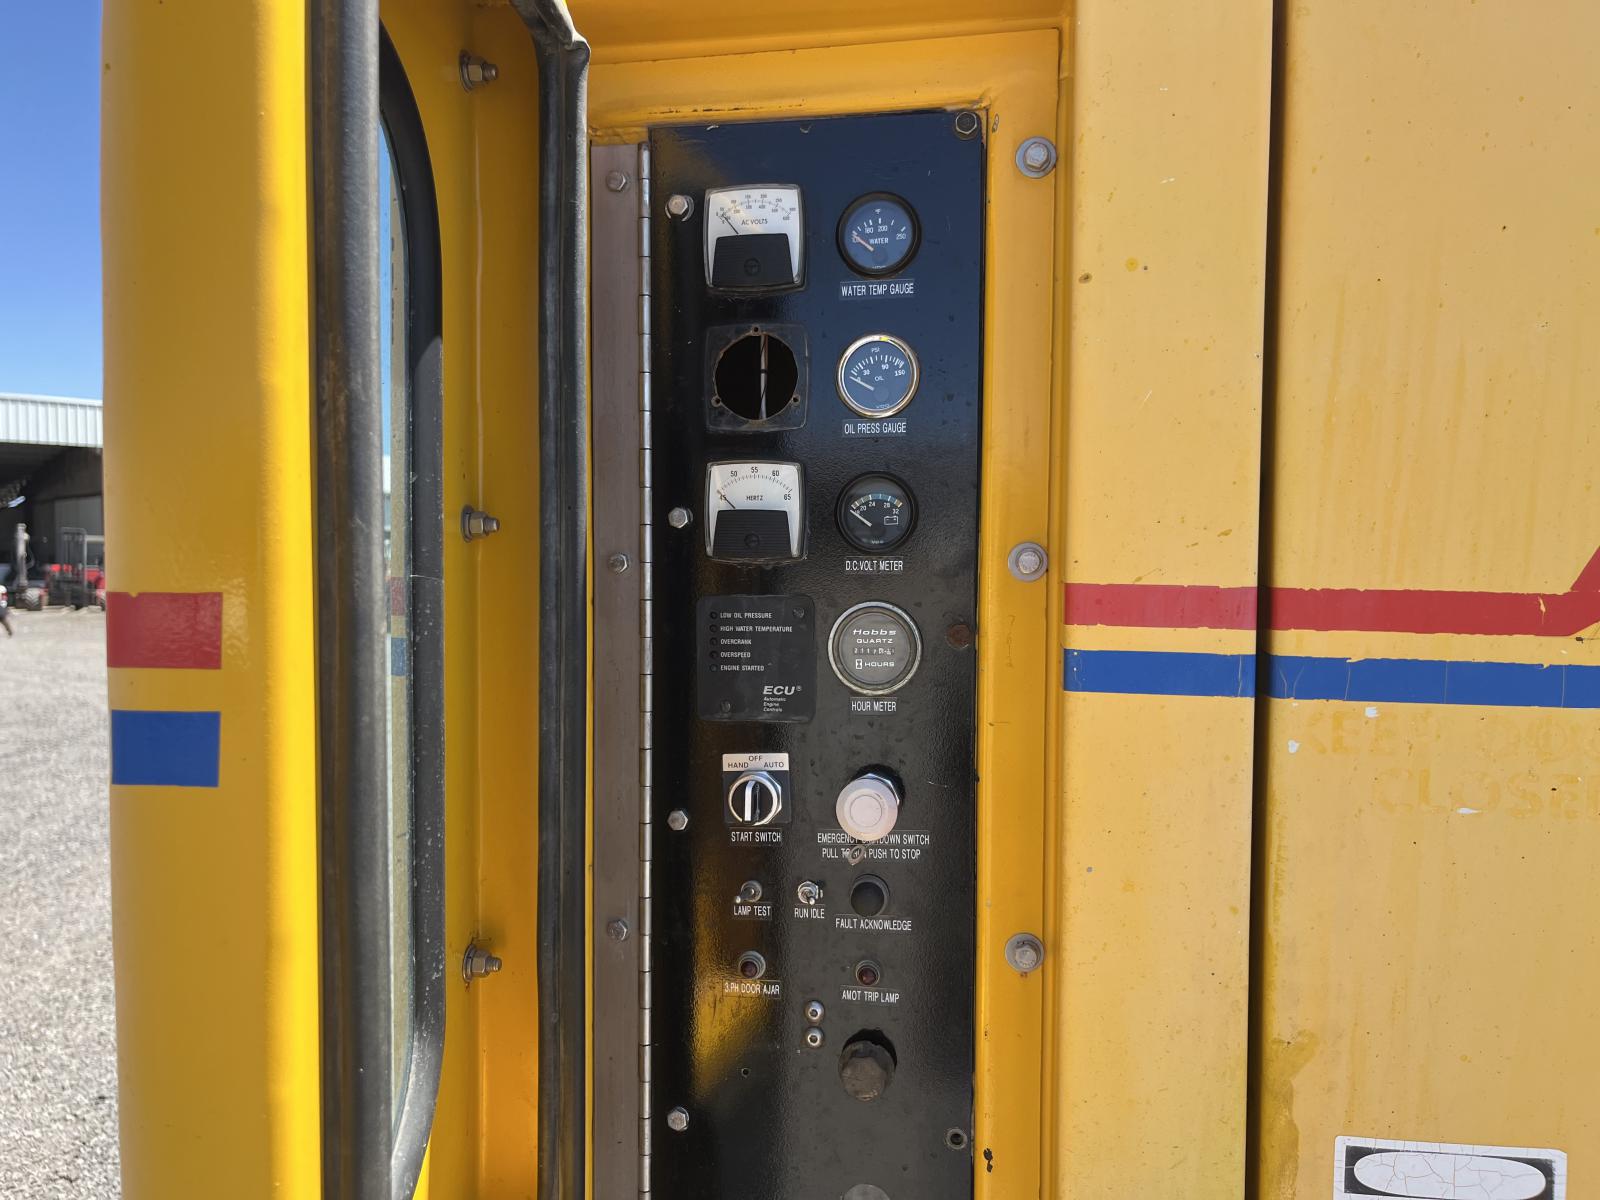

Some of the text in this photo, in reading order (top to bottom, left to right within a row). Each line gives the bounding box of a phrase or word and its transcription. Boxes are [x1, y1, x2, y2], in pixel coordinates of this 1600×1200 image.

[842, 283, 913, 296] WATER TEMP GAUGE
[845, 422, 906, 434] OIL PRESS GAUGE
[880, 561, 903, 570] METER
[852, 701, 896, 712] HOUR METER
[731, 832, 781, 842] START SWITCH
[862, 834, 900, 844] DOWN
[903, 834, 929, 845] SWITCH
[822, 848, 838, 858] PULL
[869, 849, 887, 858] PUSH
[890, 849, 900, 859] TO
[902, 849, 920, 859] STOP
[734, 906, 771, 916] LAMP TEST
[794, 908, 825, 919] RUN IDLE
[836, 918, 912, 930] FAULT ACKNOWLEDGE
[741, 984, 760, 994] DOOR
[763, 984, 780, 995] AJAR
[842, 990, 899, 1003] AMOT TRIP LAMP
